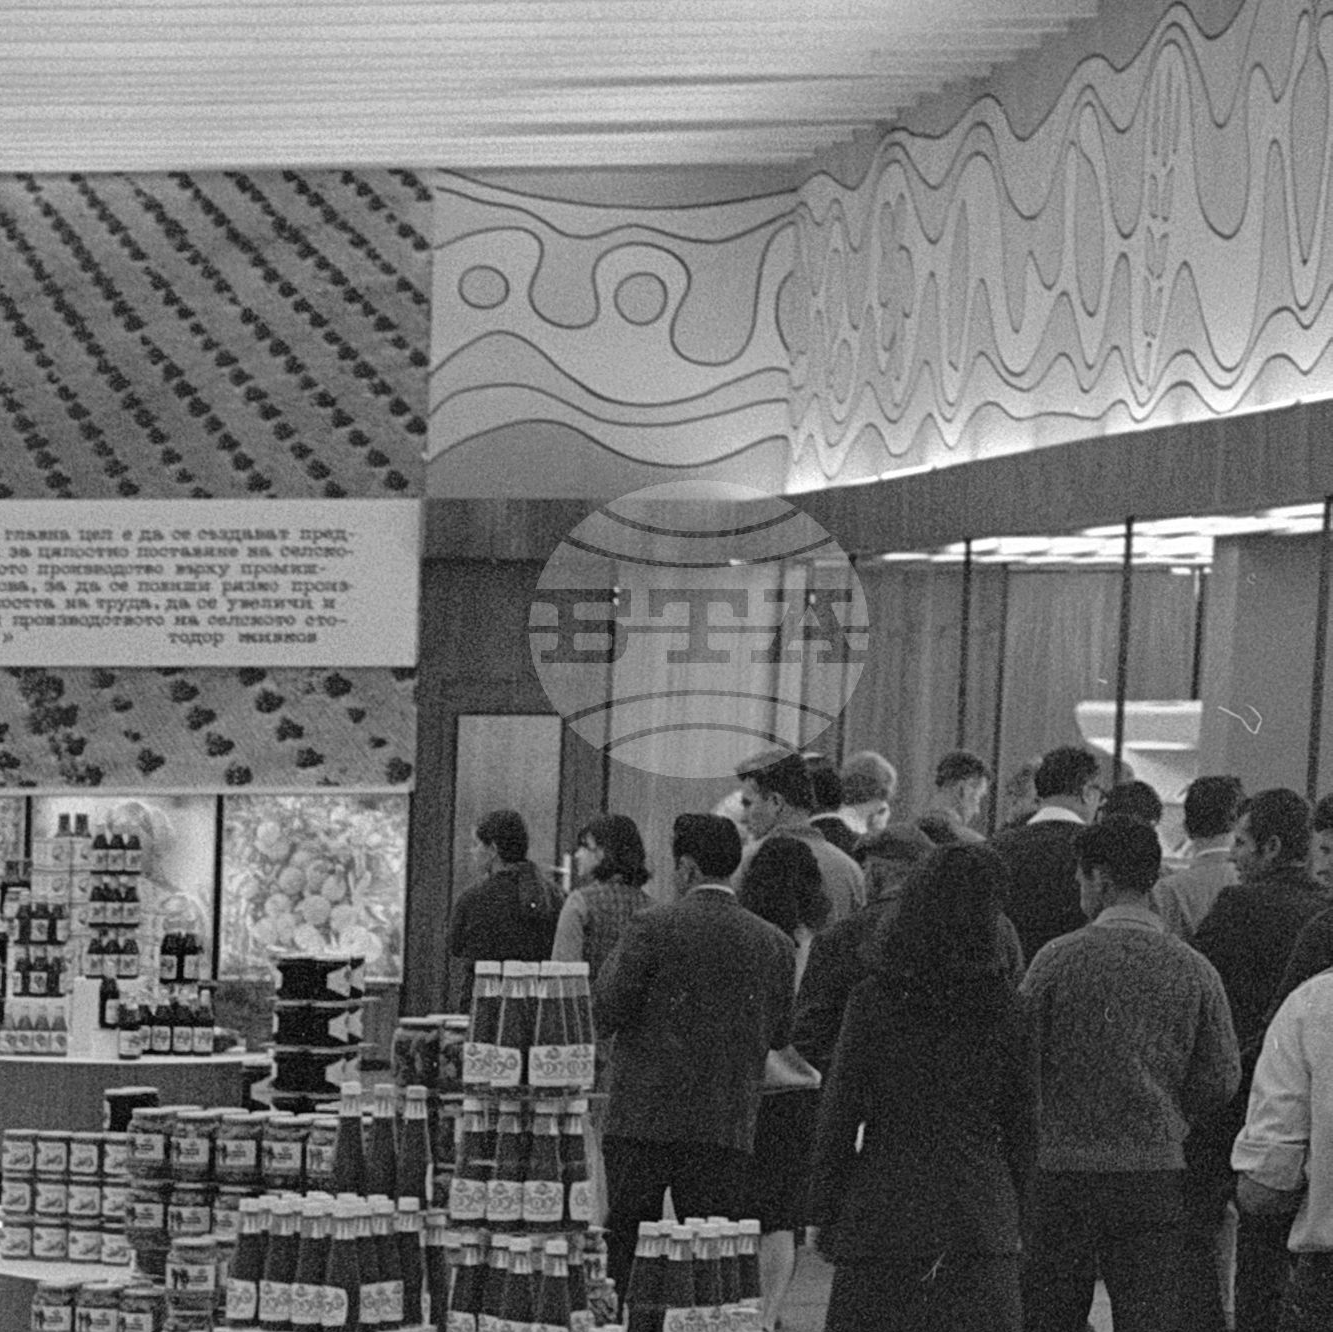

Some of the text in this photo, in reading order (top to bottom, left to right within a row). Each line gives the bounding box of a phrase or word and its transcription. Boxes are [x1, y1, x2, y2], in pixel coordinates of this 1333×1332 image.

[138, 529, 164, 543] да
[8, 547, 32, 559] за
[45, 581, 66, 593] за
[75, 581, 101, 595] да
[165, 598, 191, 612] да
